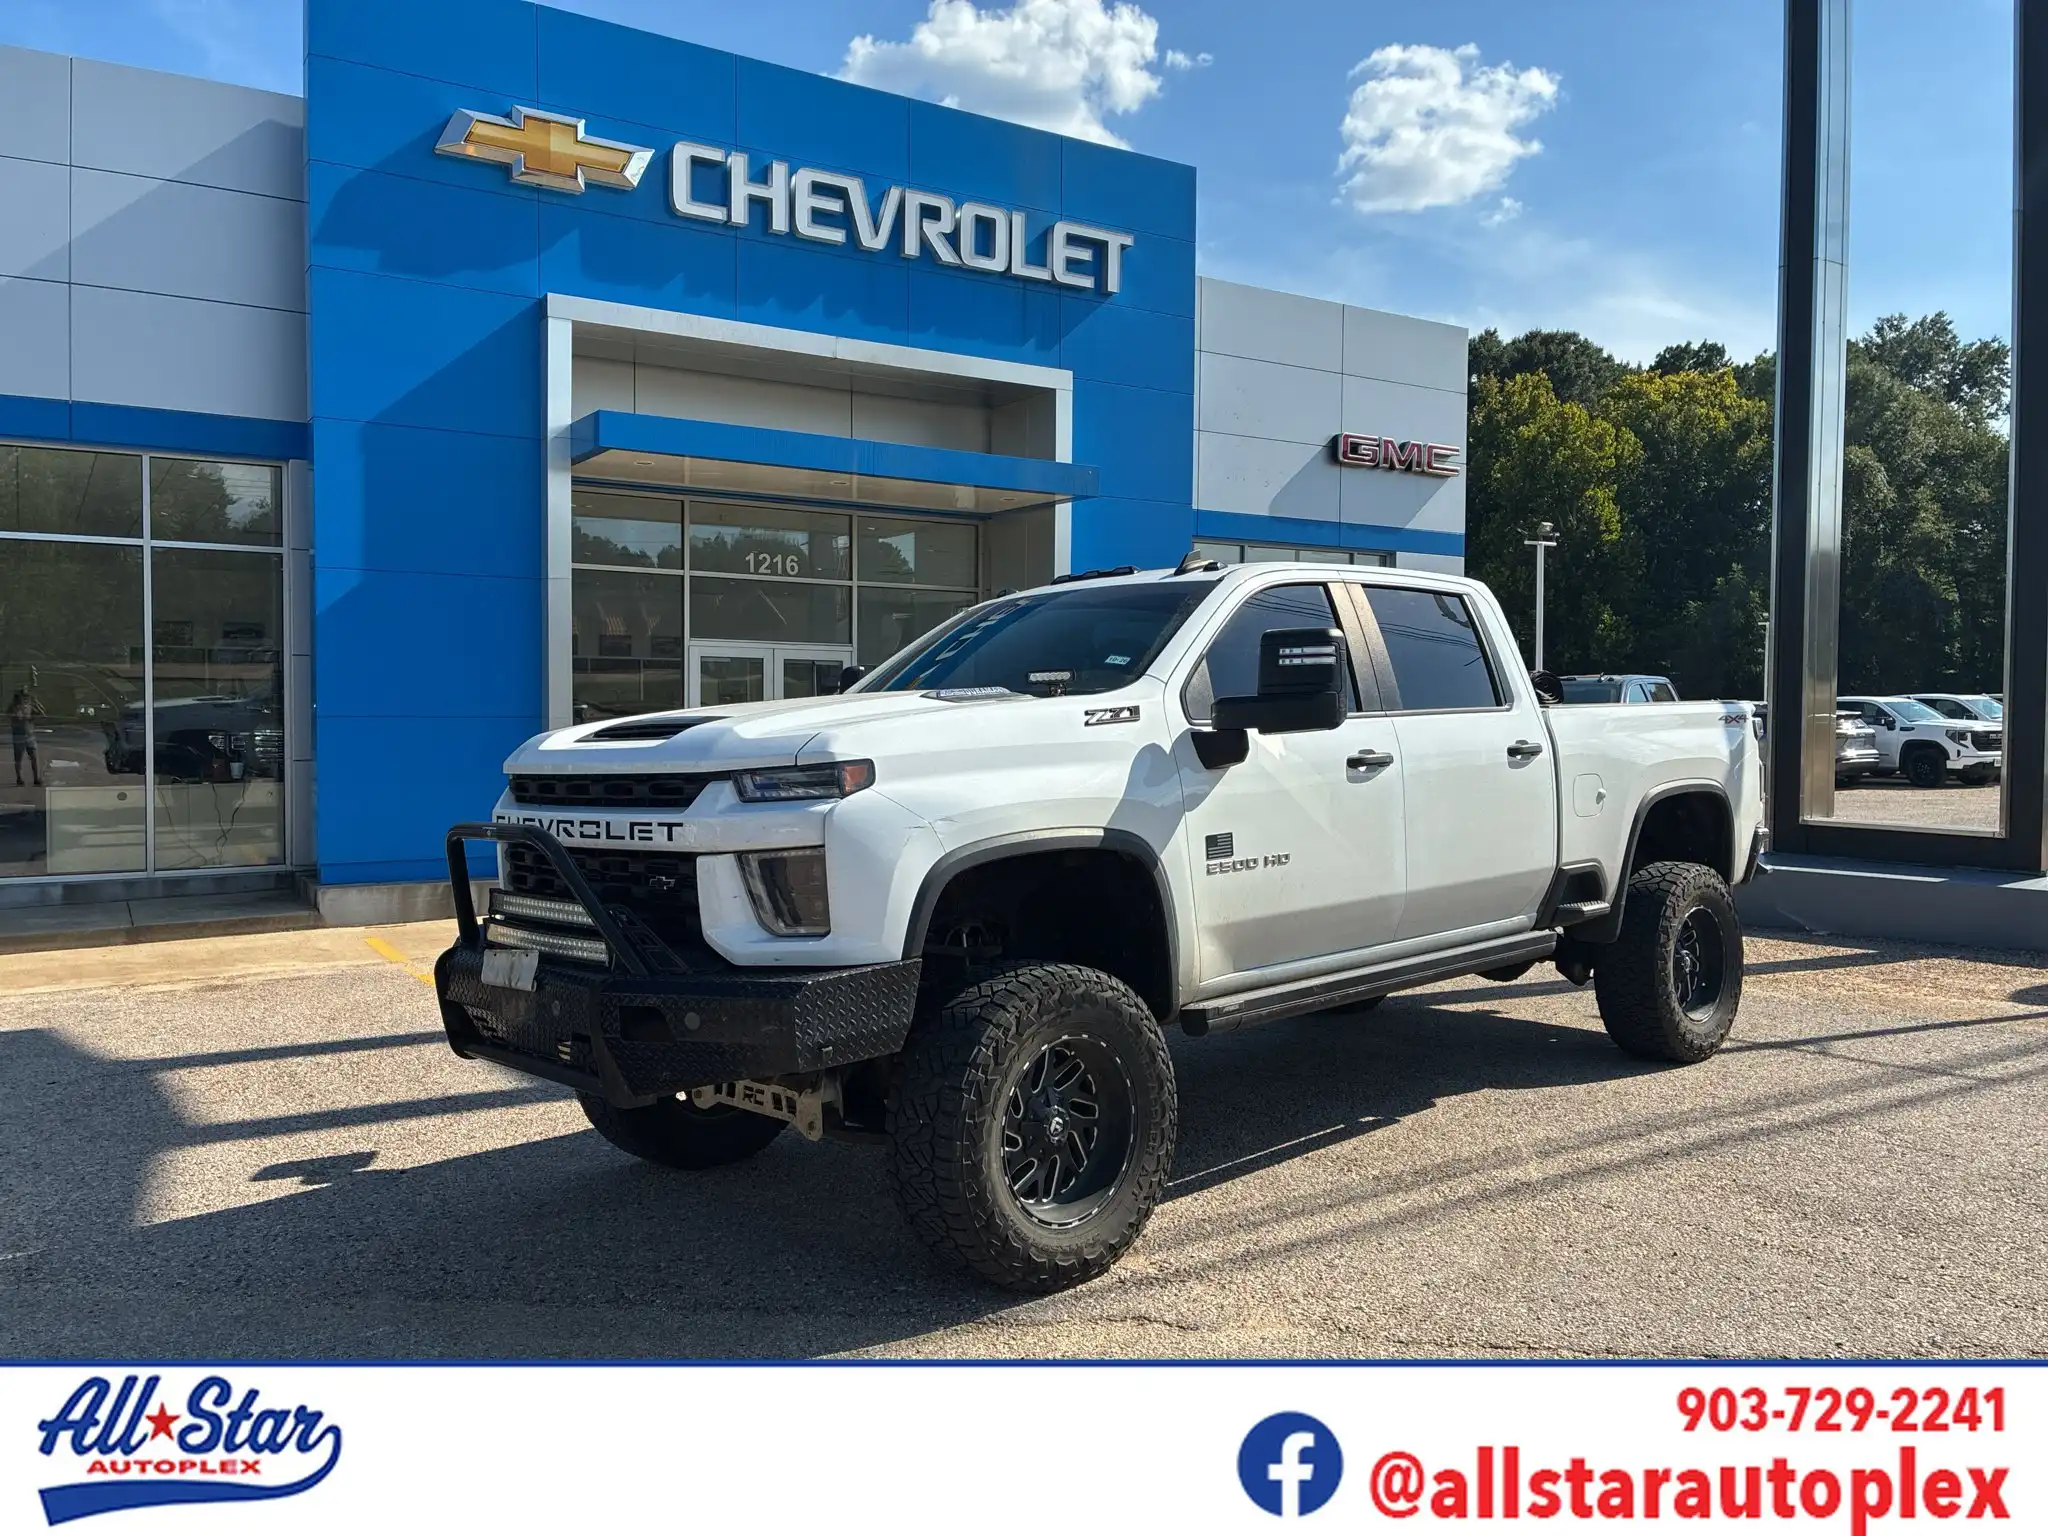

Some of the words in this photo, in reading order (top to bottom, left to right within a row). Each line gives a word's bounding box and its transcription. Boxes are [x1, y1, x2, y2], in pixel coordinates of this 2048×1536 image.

[672, 141, 1133, 294] CHEVROLET
[1338, 432, 1461, 477] GMC
[745, 552, 799, 575] 1216
[1084, 705, 1140, 727] Z71
[1206, 858, 1259, 876] 2500
[1263, 853, 1291, 869] HD
